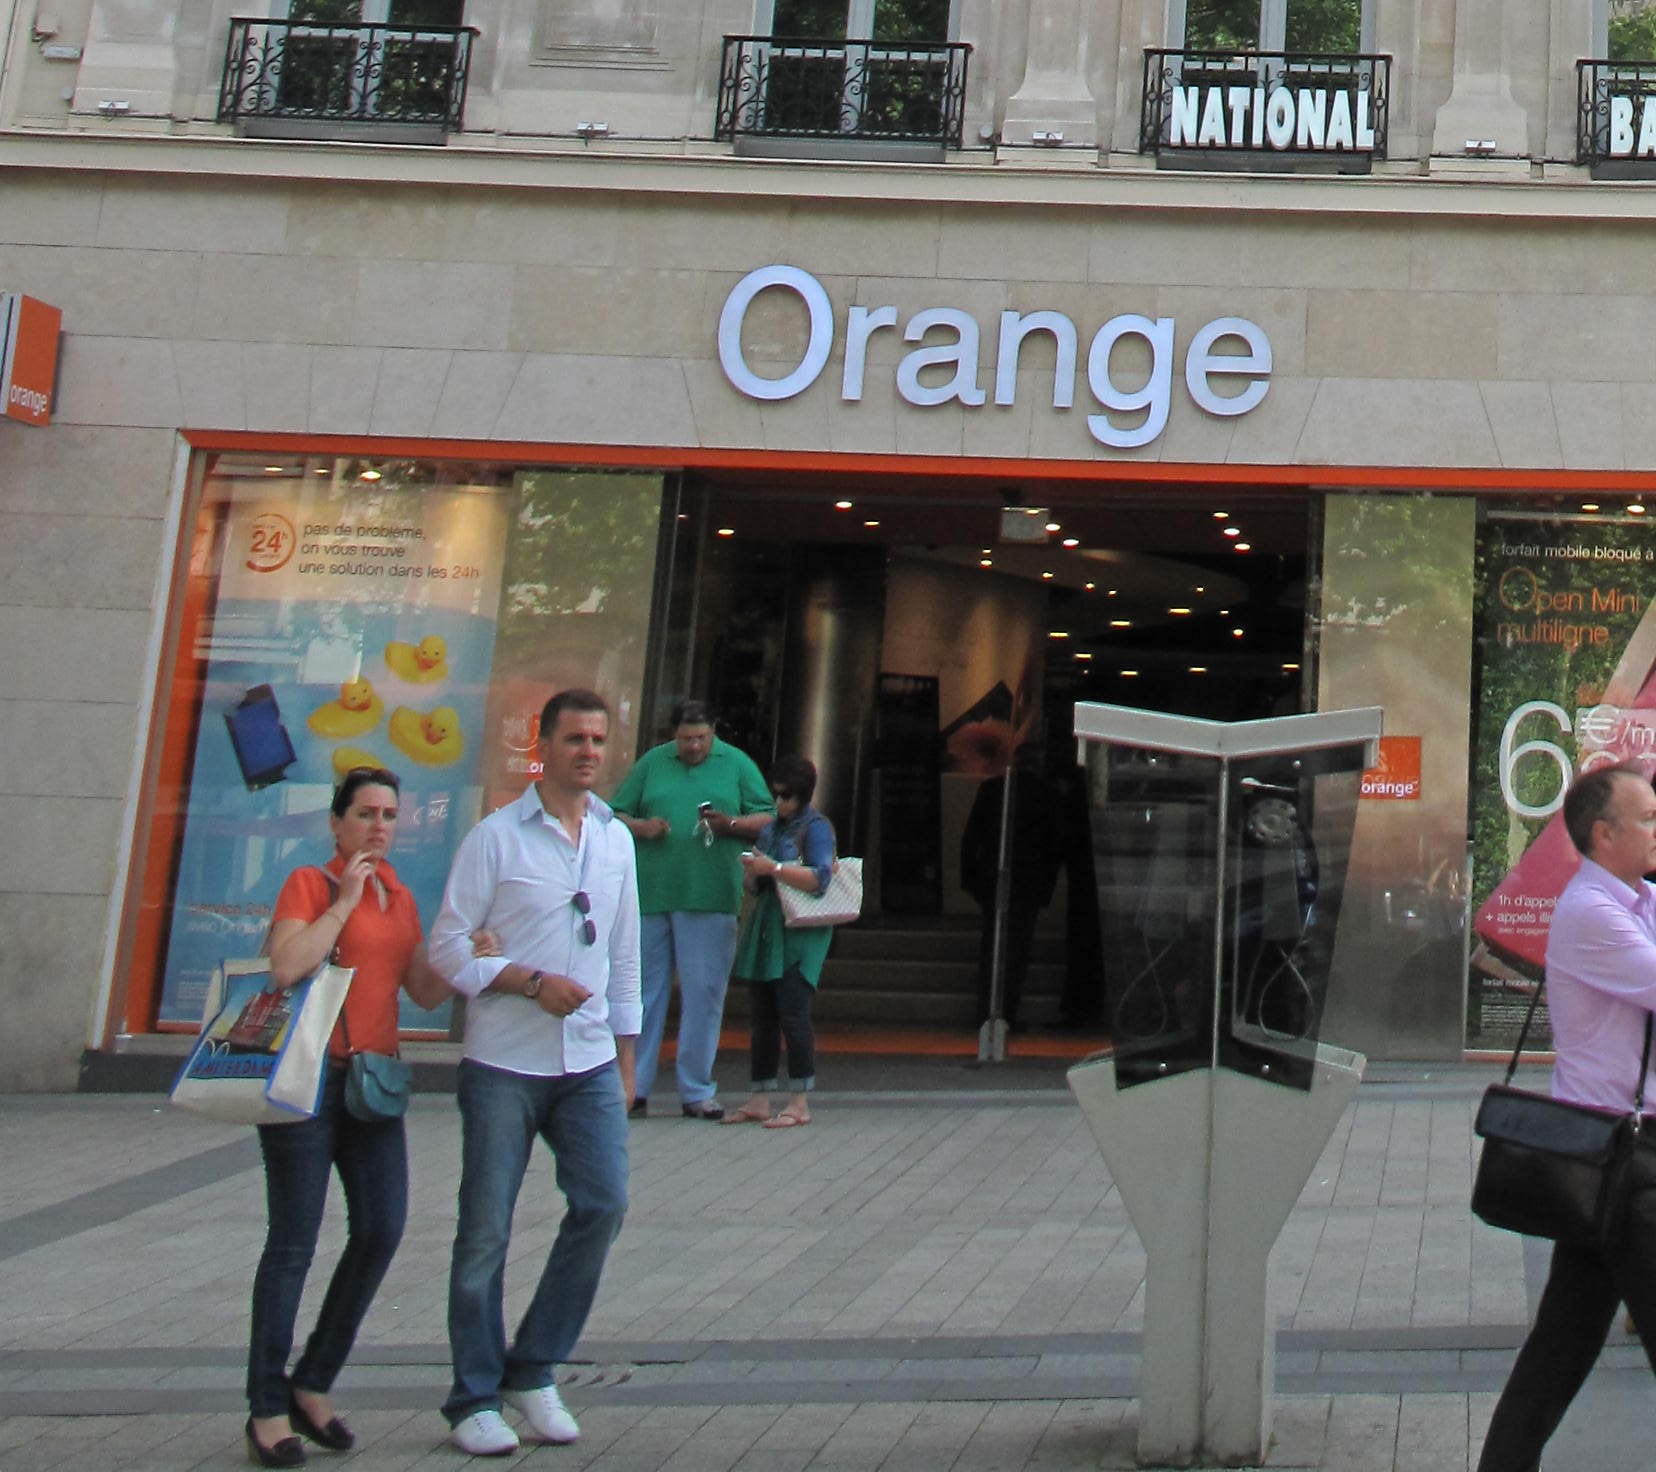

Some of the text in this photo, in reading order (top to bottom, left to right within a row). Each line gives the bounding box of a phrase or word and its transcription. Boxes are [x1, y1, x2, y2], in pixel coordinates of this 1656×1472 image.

[1169, 86, 1375, 151] NATIONAL
[718, 263, 1273, 448] Orange
[10, 384, 48, 417] orange
[303, 524, 329, 538] pas
[333, 522, 352, 536] de
[301, 544, 320, 554] on
[323, 545, 357, 556] vous
[1501, 542, 1541, 557] forfait
[1545, 545, 1590, 559] mobile
[1594, 545, 1642, 562] bloqué
[298, 561, 480, 579] une solution dans les 24h
[1499, 567, 1640, 616] Open Mini
[1497, 617, 1609, 651] multiligne
[1498, 700, 1573, 817] 6
[1360, 782, 1414, 798] orange
[1497, 911, 1537, 925] appels
